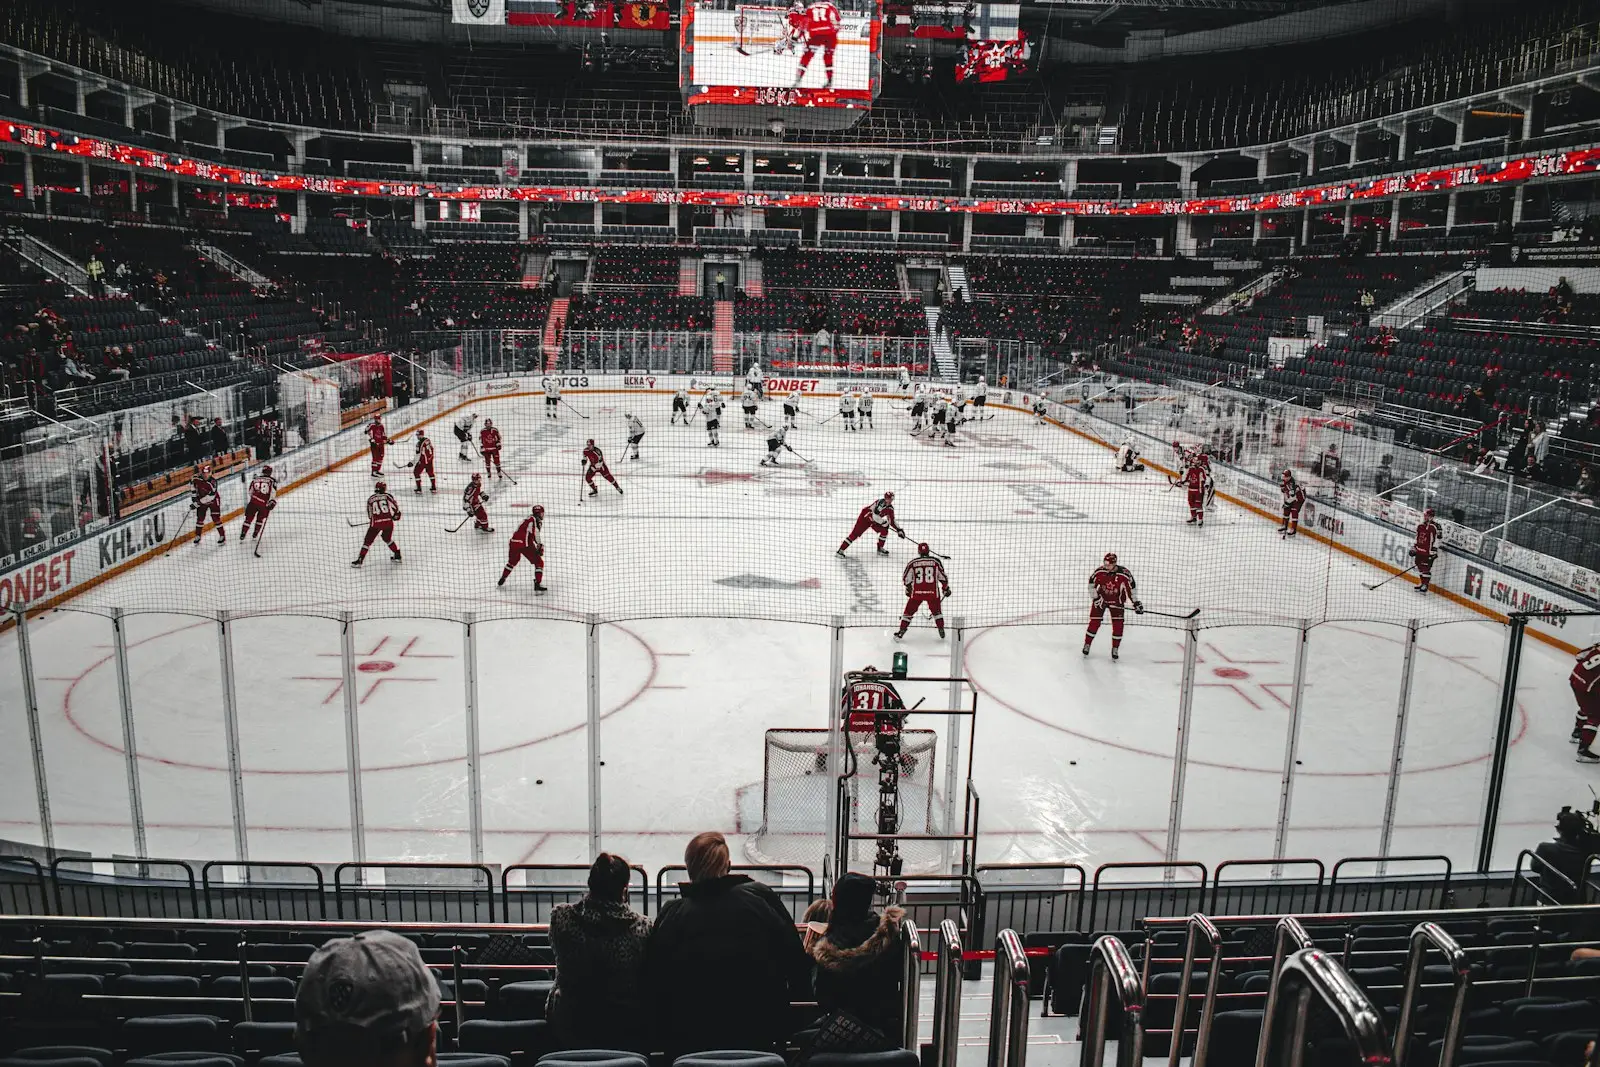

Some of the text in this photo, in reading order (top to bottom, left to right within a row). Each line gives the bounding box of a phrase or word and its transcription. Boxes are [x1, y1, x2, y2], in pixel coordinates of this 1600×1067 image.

[755, 88, 797, 105] ЦСКА
[933, 159, 952, 169] 412
[390, 185, 421, 197] ЦСКА
[909, 200, 939, 211] ЦСКА
[694, 206, 712, 215] 318
[783, 208, 802, 217] 319
[624, 377, 645, 386] ЦСКА
[372, 500, 389, 515] 46
[57, 530, 79, 545] KHL.RU
[100, 512, 165, 570] KHL.RU
[23, 543, 47, 560] KHL.RU
[915, 566, 935, 584] 38
[856, 691, 880, 710] 31
